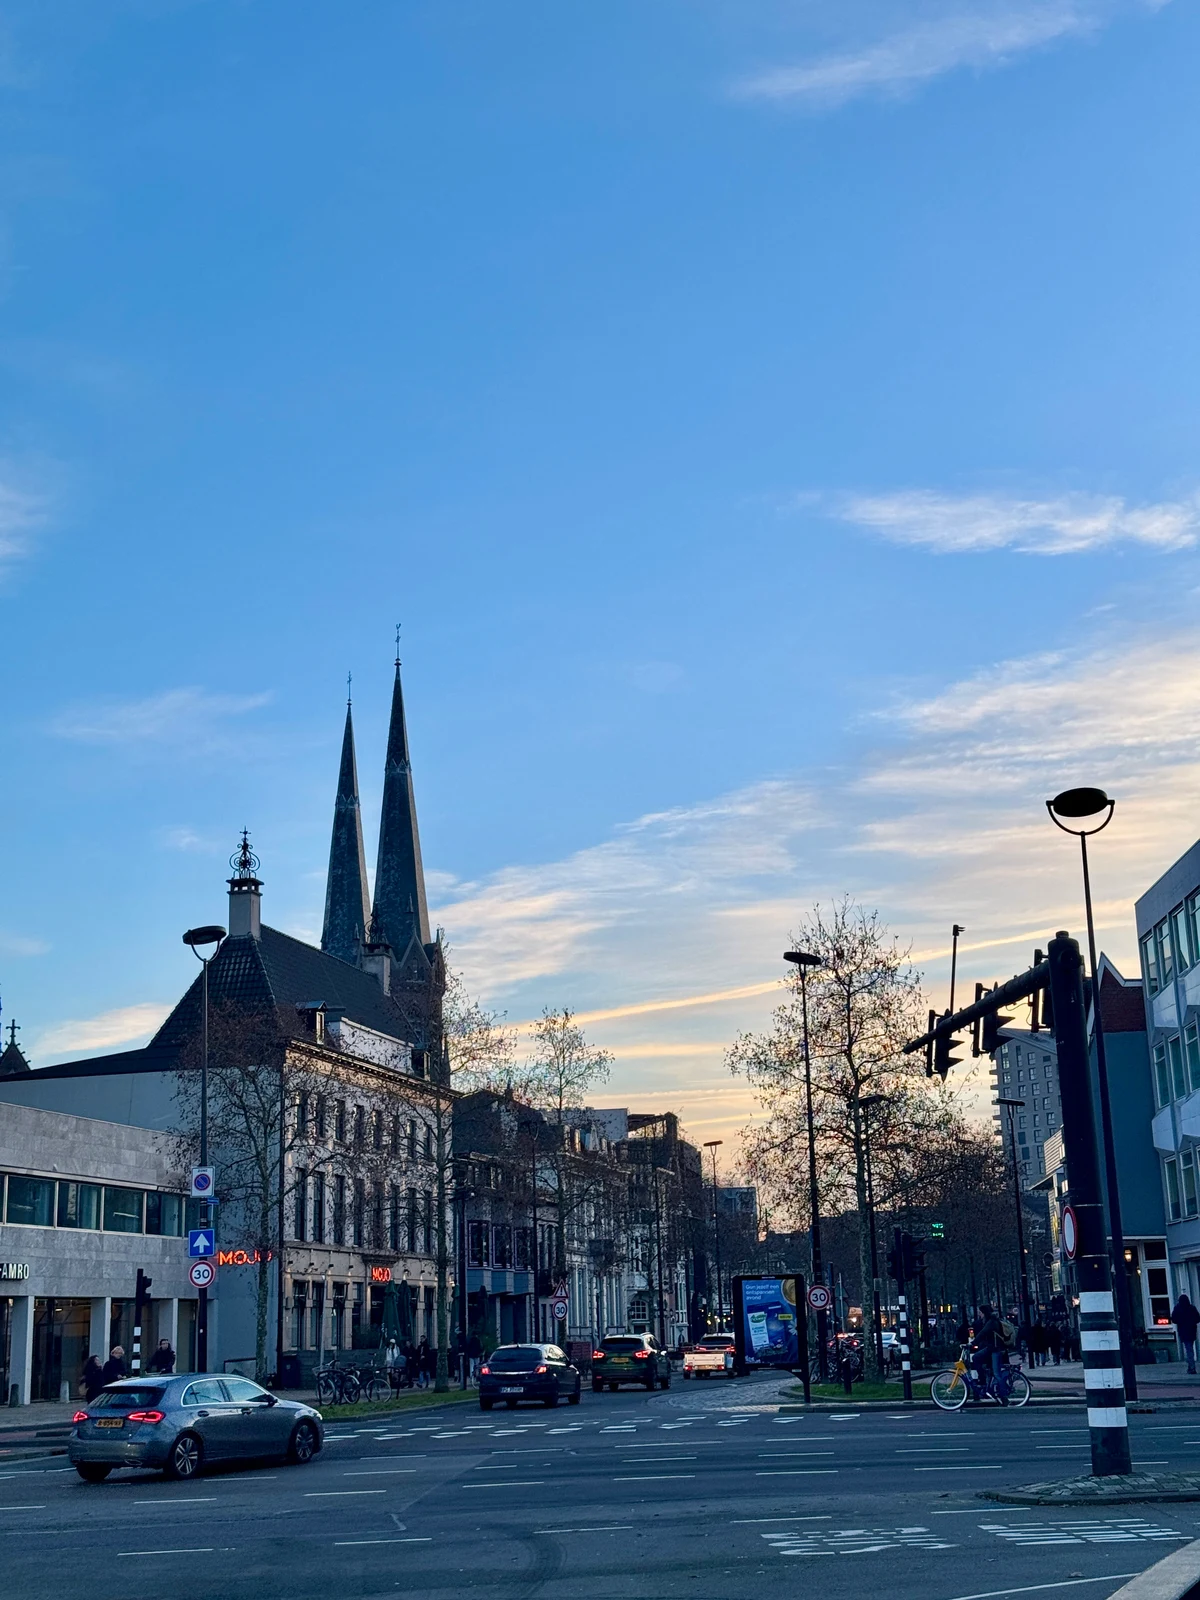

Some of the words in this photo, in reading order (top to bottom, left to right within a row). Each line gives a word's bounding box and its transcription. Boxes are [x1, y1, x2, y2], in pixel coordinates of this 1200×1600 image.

[194, 1269, 210, 1280] 30
[372, 1266, 391, 1281] MOJO
[811, 1292, 826, 1302] 30
[555, 1306, 565, 1315] 30
